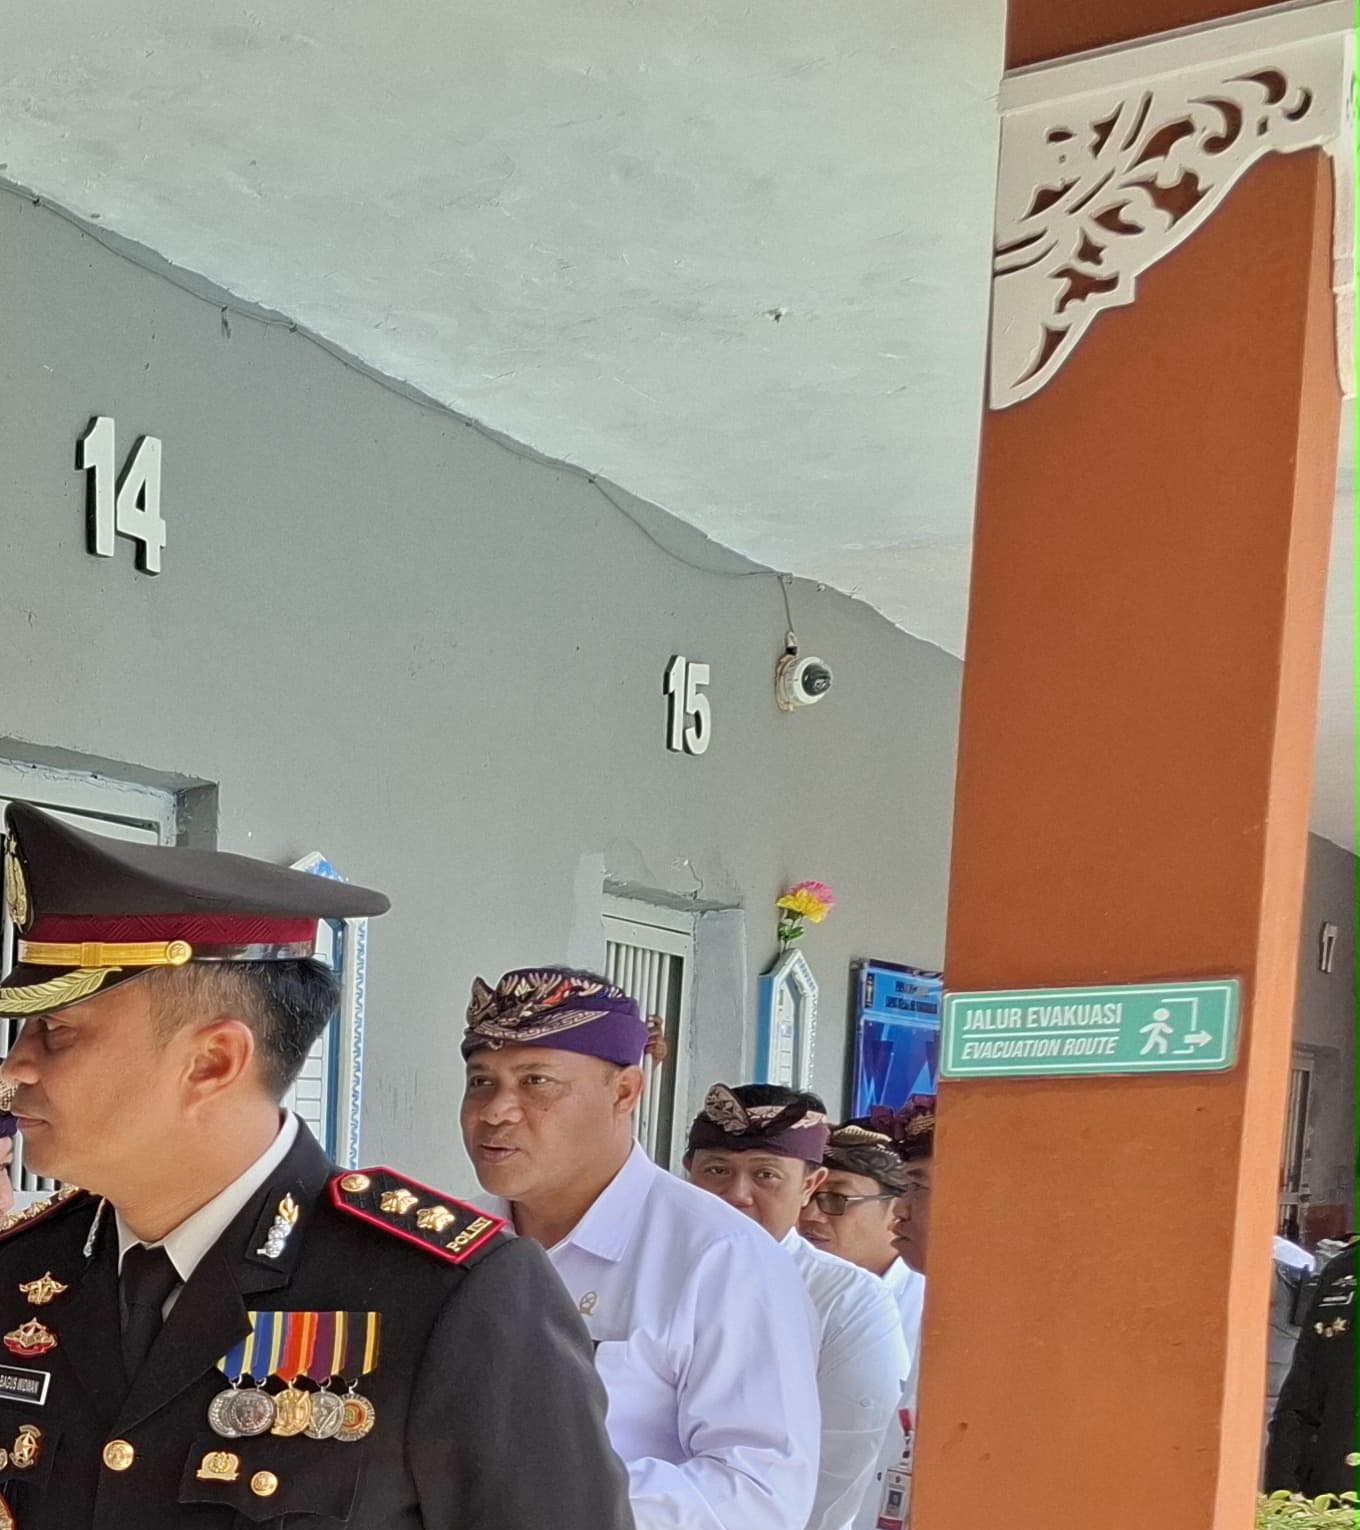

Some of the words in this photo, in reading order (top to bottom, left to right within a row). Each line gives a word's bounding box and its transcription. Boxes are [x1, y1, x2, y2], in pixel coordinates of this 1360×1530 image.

[79, 415, 166, 575] 14
[666, 655, 711, 755] 15
[962, 1007, 1022, 1031] JALUR
[1026, 1003, 1123, 1028] EVAKUASI
[960, 1039, 1060, 1061] EVACUATION
[1062, 1036, 1120, 1056] ROUTE
[446, 1216, 493, 1252] POLISI
